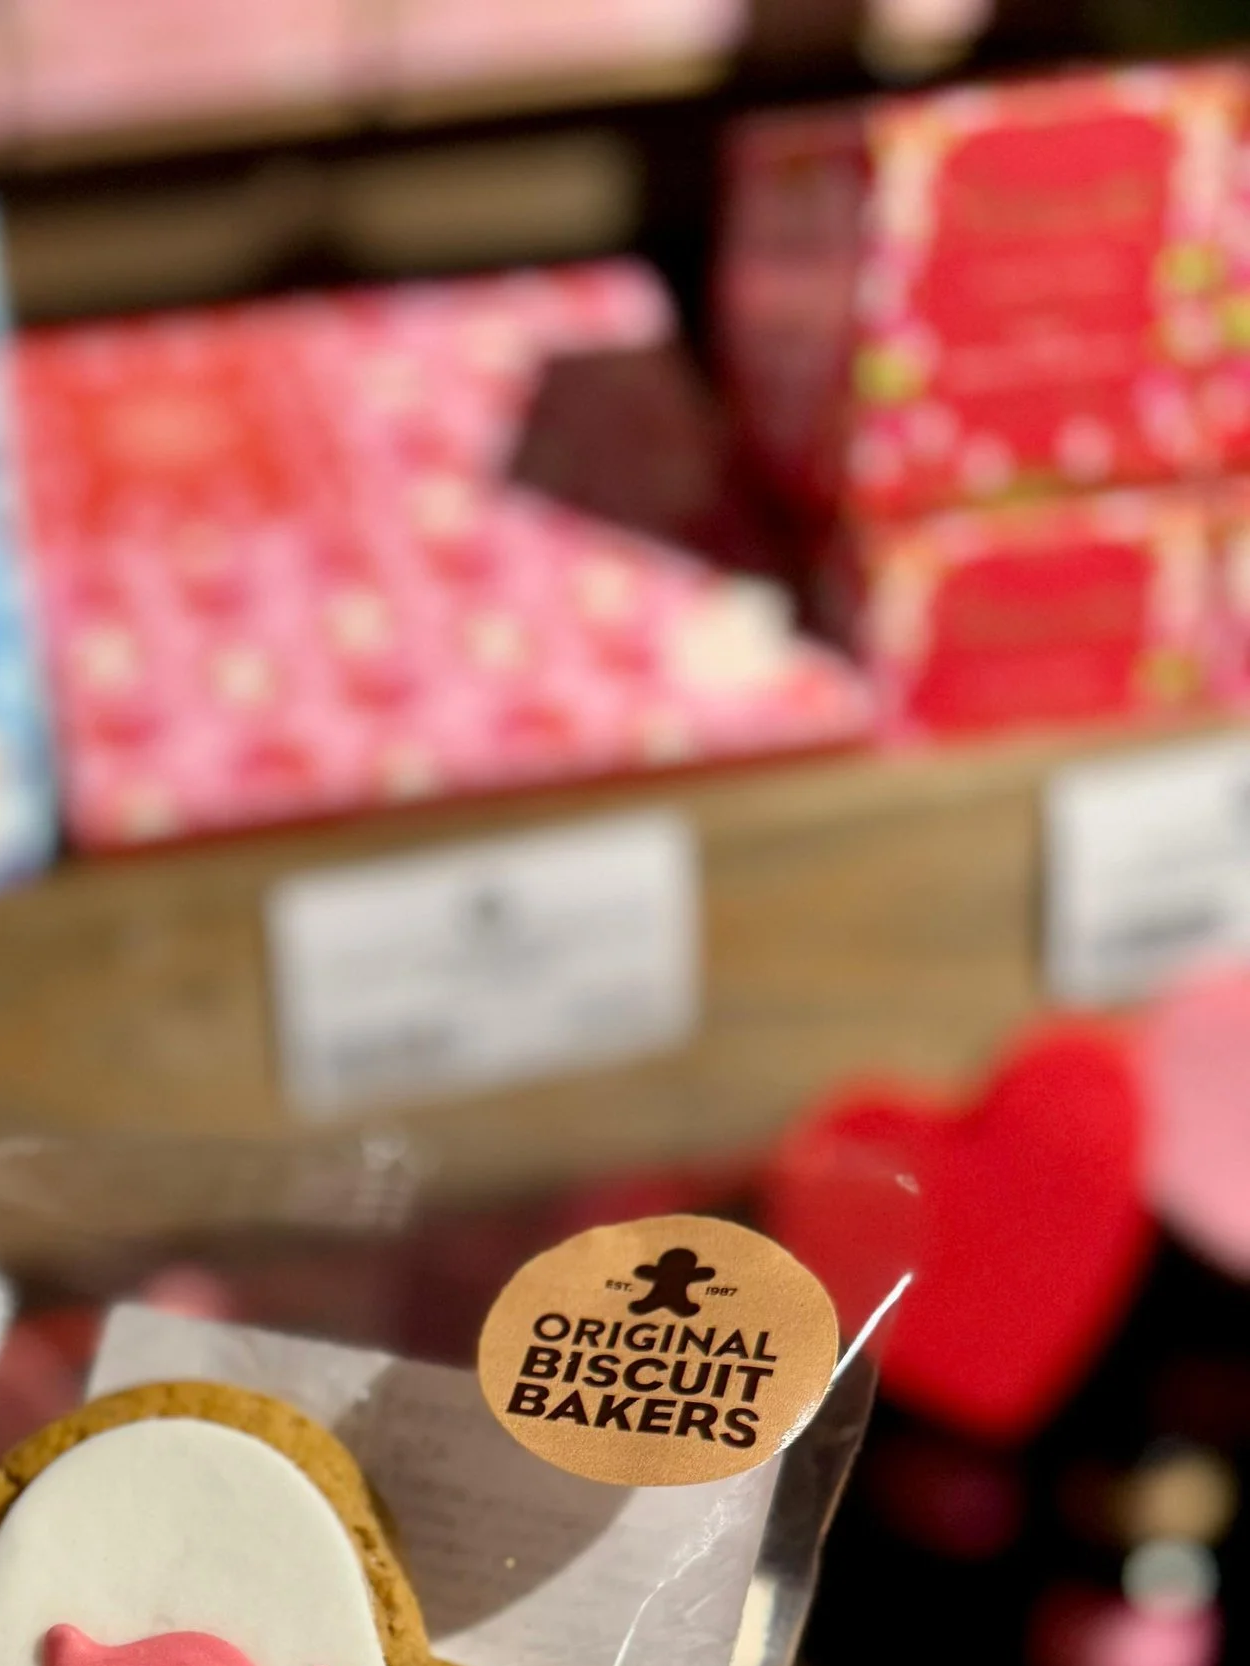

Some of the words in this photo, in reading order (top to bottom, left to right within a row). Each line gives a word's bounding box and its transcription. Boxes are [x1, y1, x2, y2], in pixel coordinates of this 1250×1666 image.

[605, 1279, 632, 1293] EST.
[705, 1286, 738, 1298] 1987
[533, 1313, 779, 1363] ORIGINAL
[519, 1346, 774, 1403] BISCUIT
[506, 1382, 760, 1450] BAKERS
